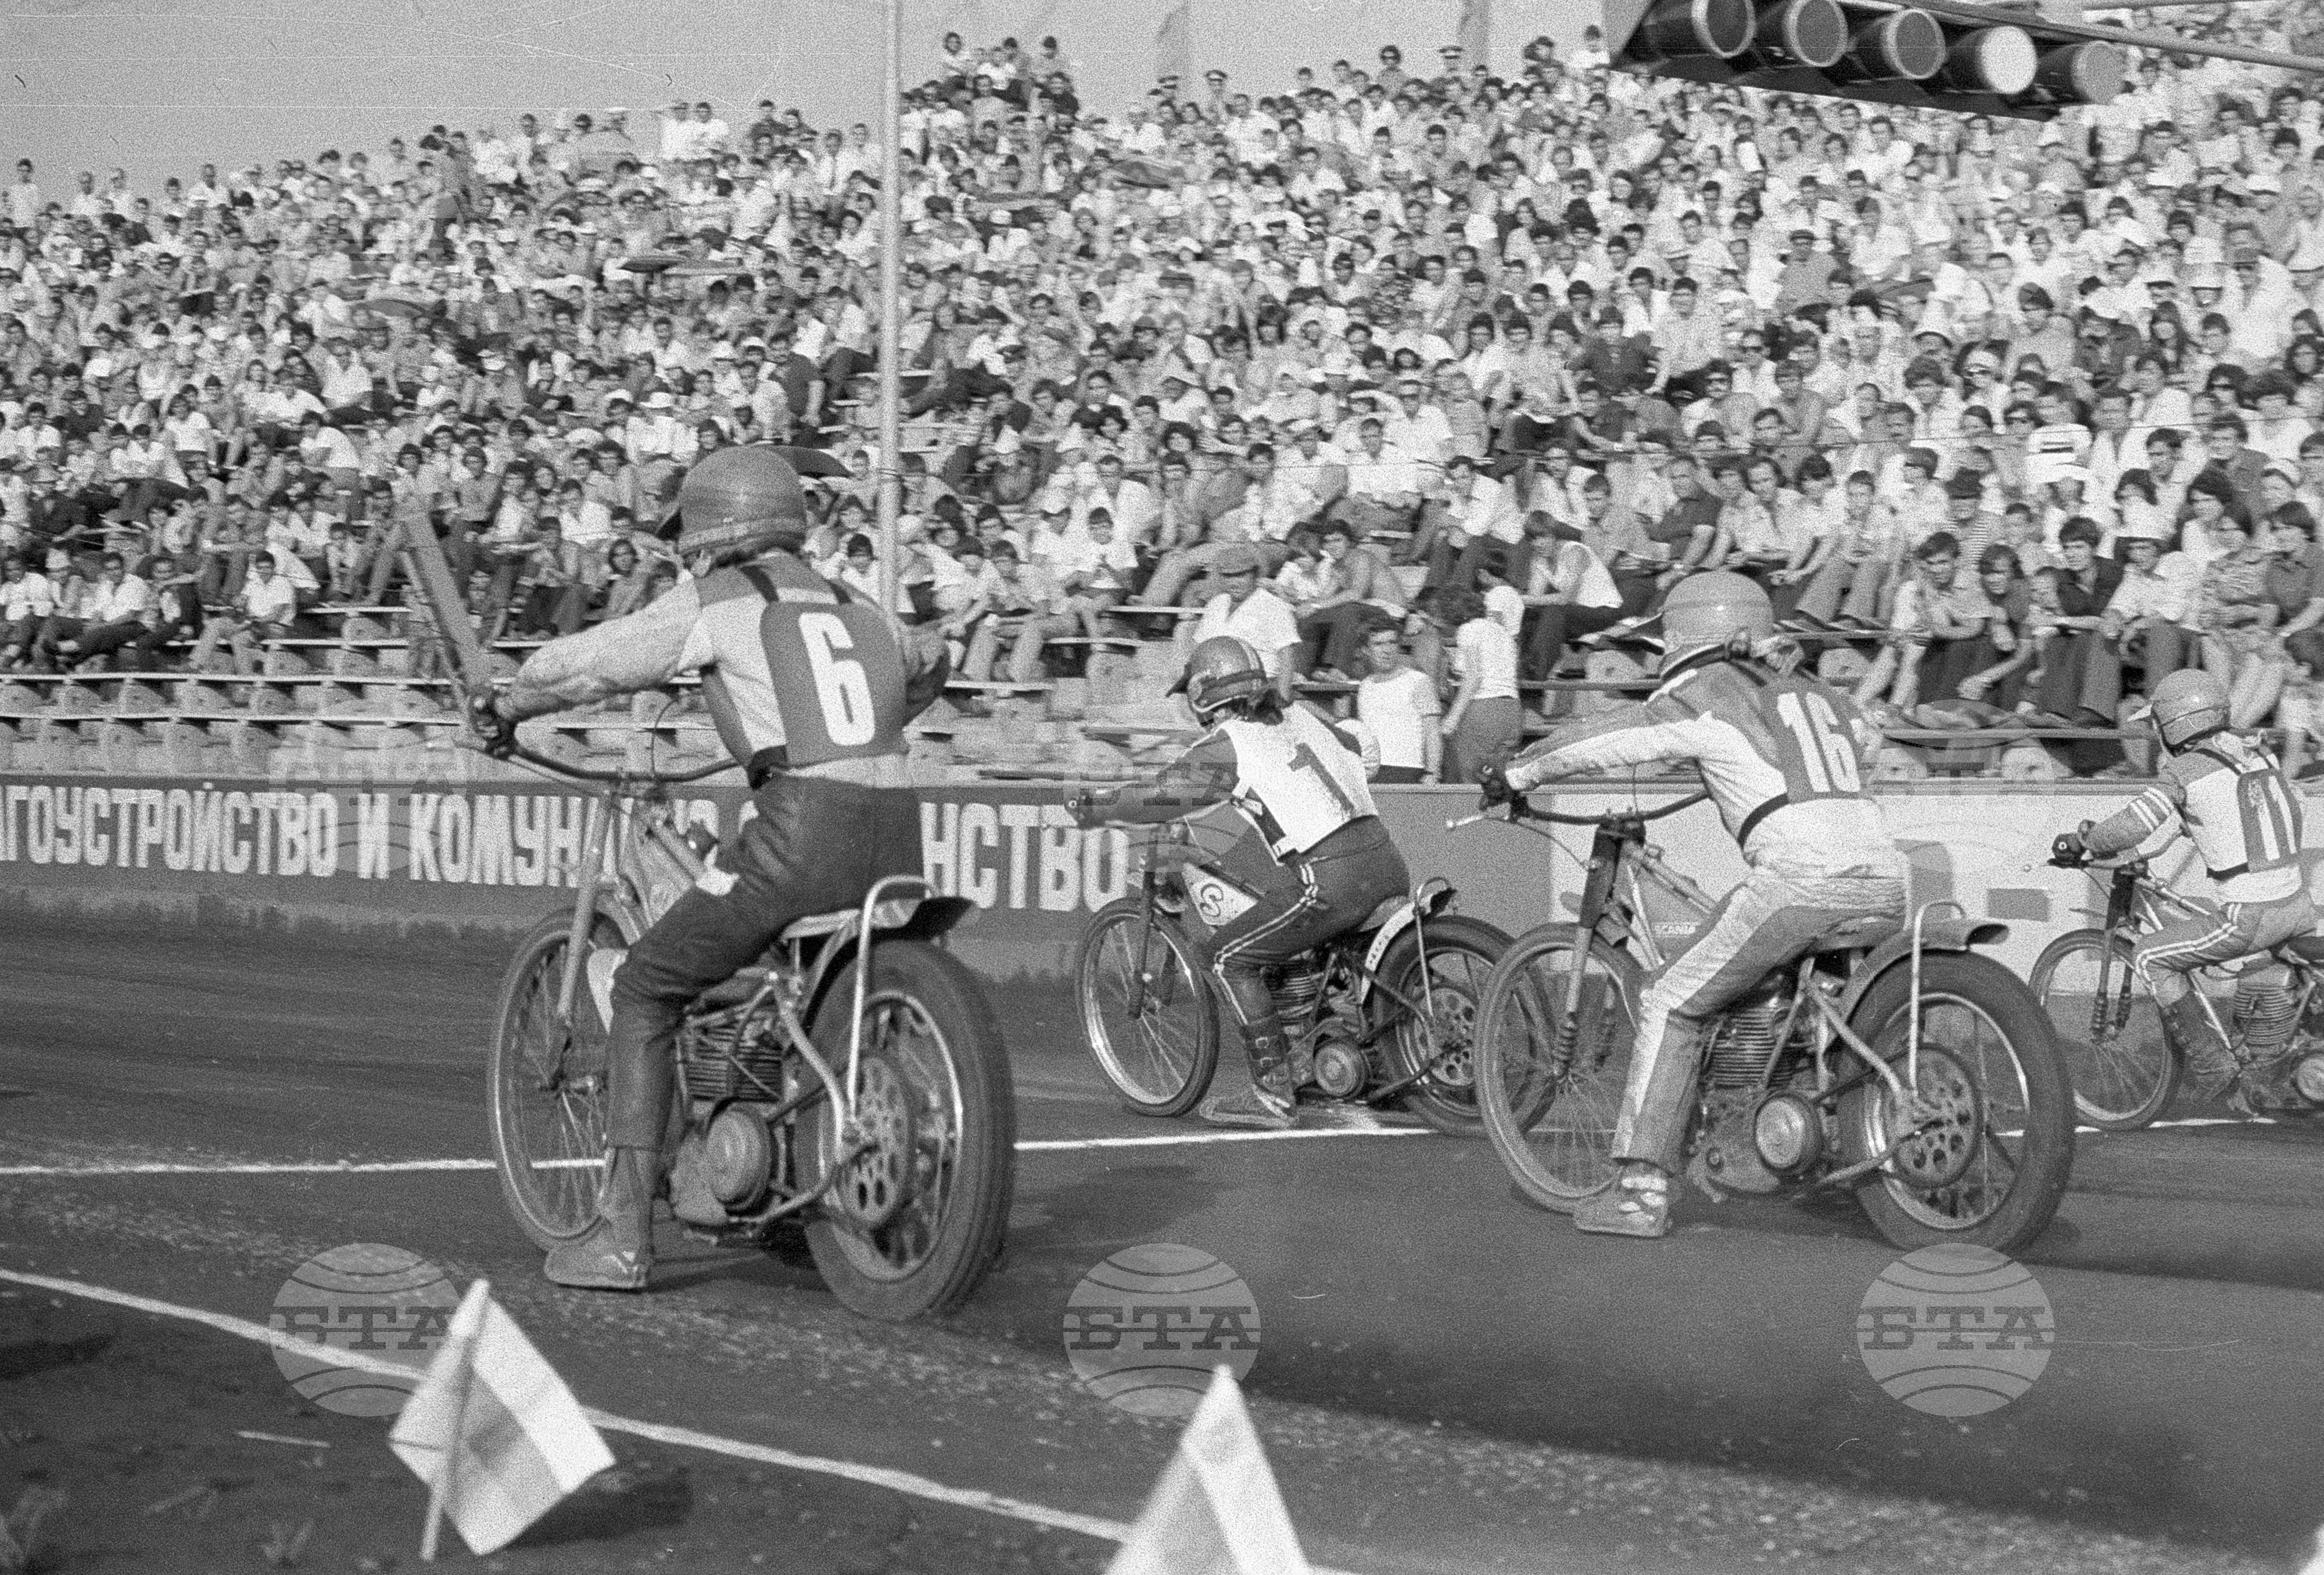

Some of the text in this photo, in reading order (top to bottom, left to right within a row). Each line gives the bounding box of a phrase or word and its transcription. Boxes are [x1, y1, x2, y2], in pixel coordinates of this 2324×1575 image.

[798, 612, 876, 747] 6
[1287, 742, 1354, 811] 1
[1777, 692, 1861, 792] 16
[357, 794, 390, 879] И
[2248, 776, 2297, 861] 11
